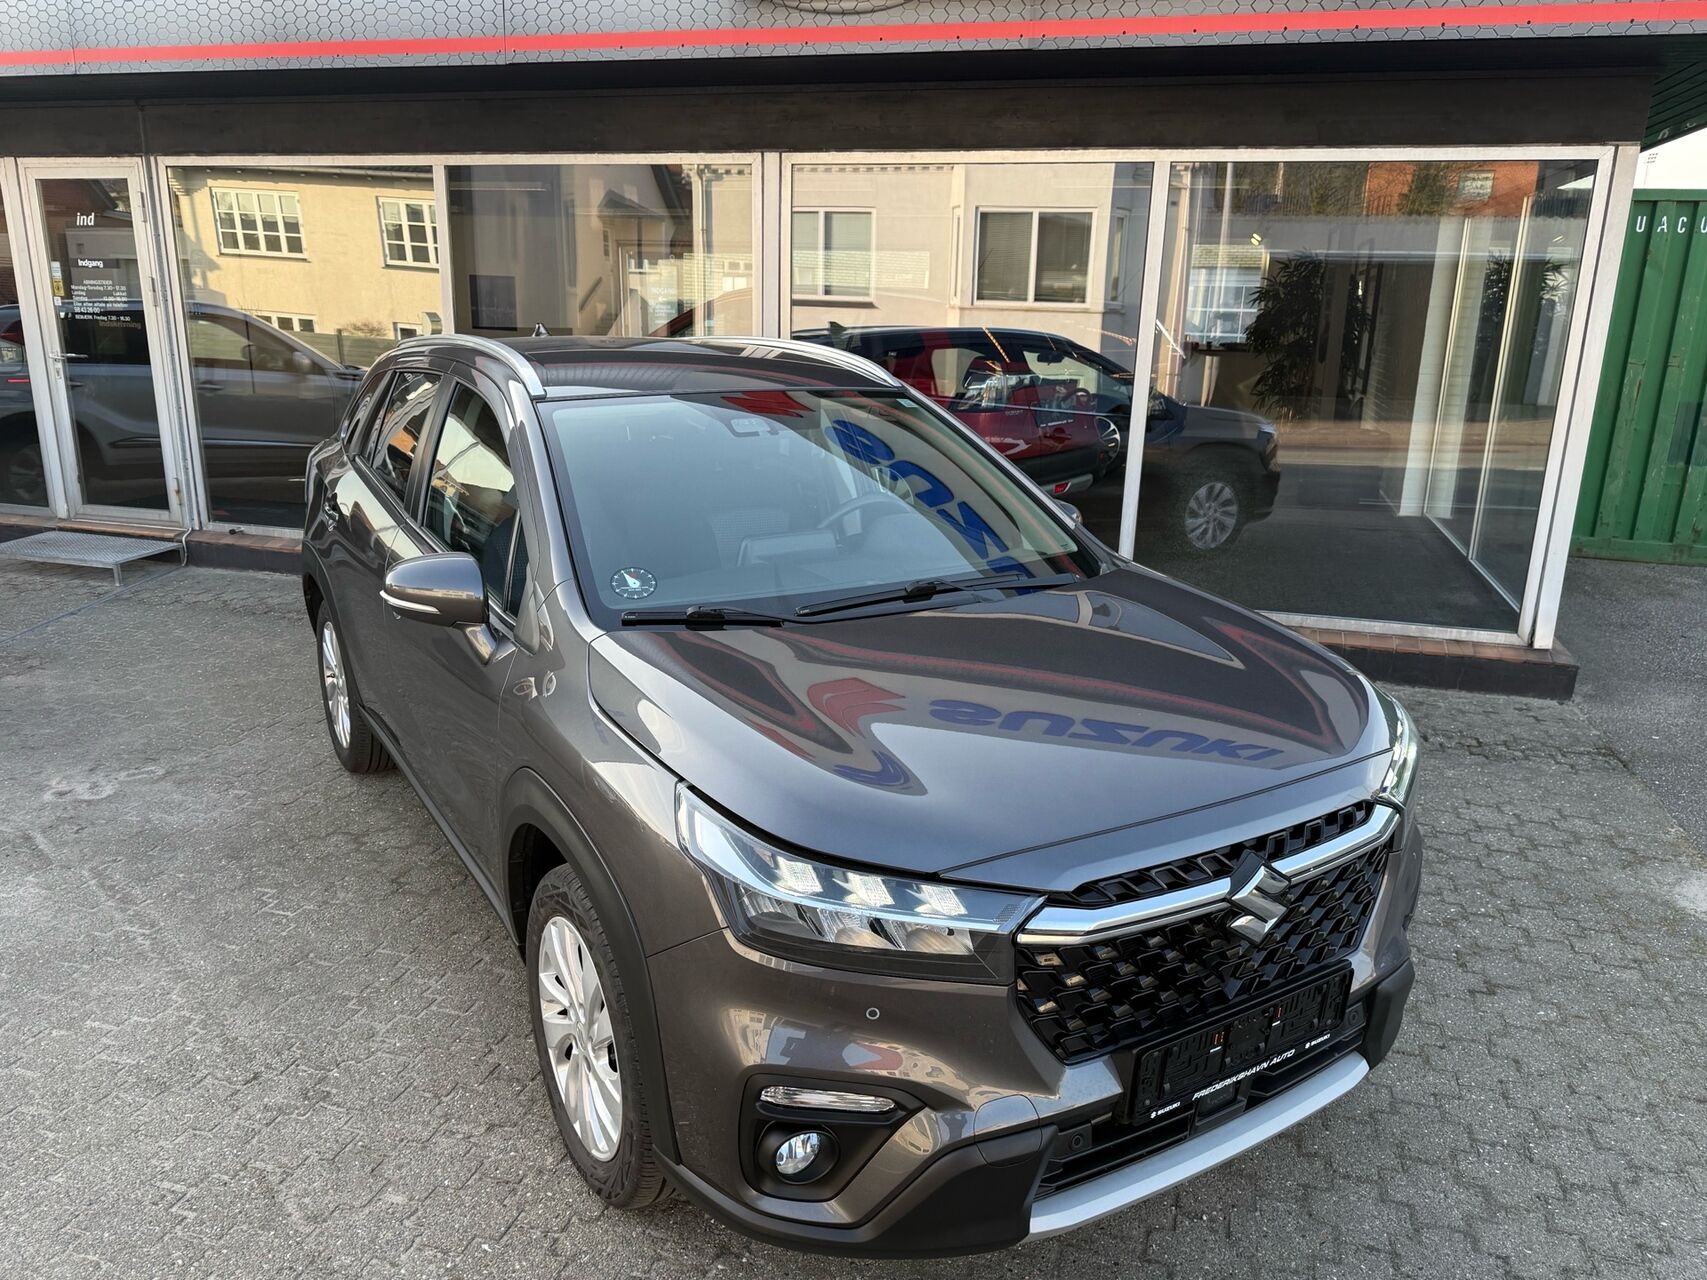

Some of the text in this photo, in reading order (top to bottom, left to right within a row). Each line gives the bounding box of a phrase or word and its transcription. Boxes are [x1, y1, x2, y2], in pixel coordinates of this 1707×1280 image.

[76, 212, 95, 226] ind
[77, 258, 104, 268] Indgang
[1269, 1048, 1296, 1066] AUTO
